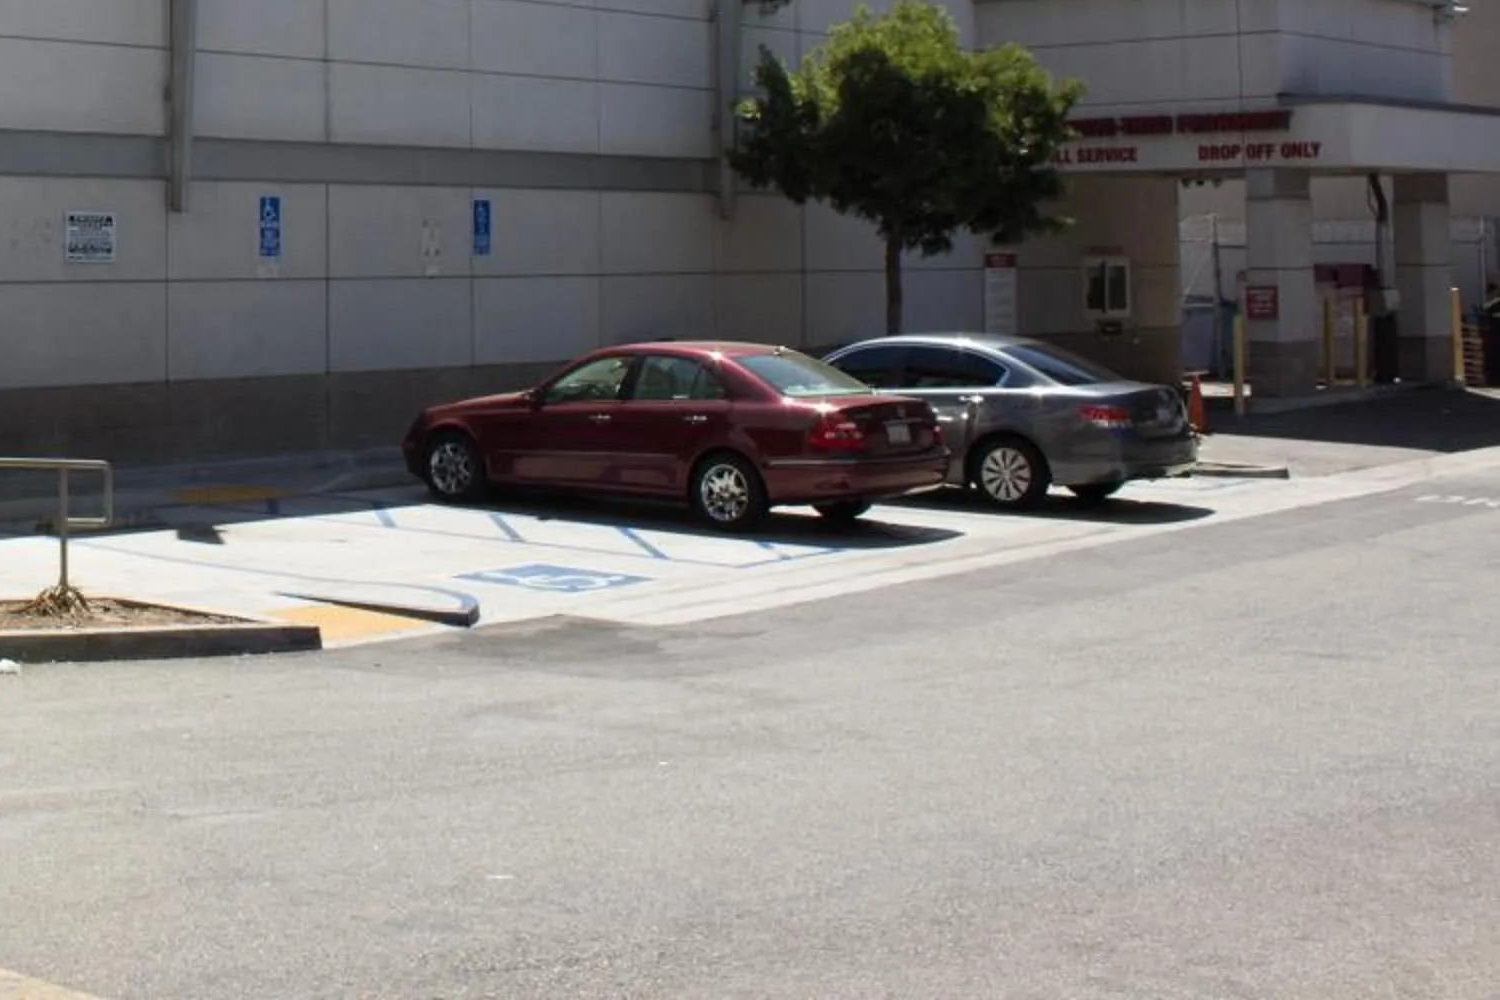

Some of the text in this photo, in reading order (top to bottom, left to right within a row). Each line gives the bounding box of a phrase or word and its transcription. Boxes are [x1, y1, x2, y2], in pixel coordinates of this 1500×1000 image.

[1076, 146, 1138, 164] SERVICE
[1197, 140, 1322, 162] DROP OFF ONLY
